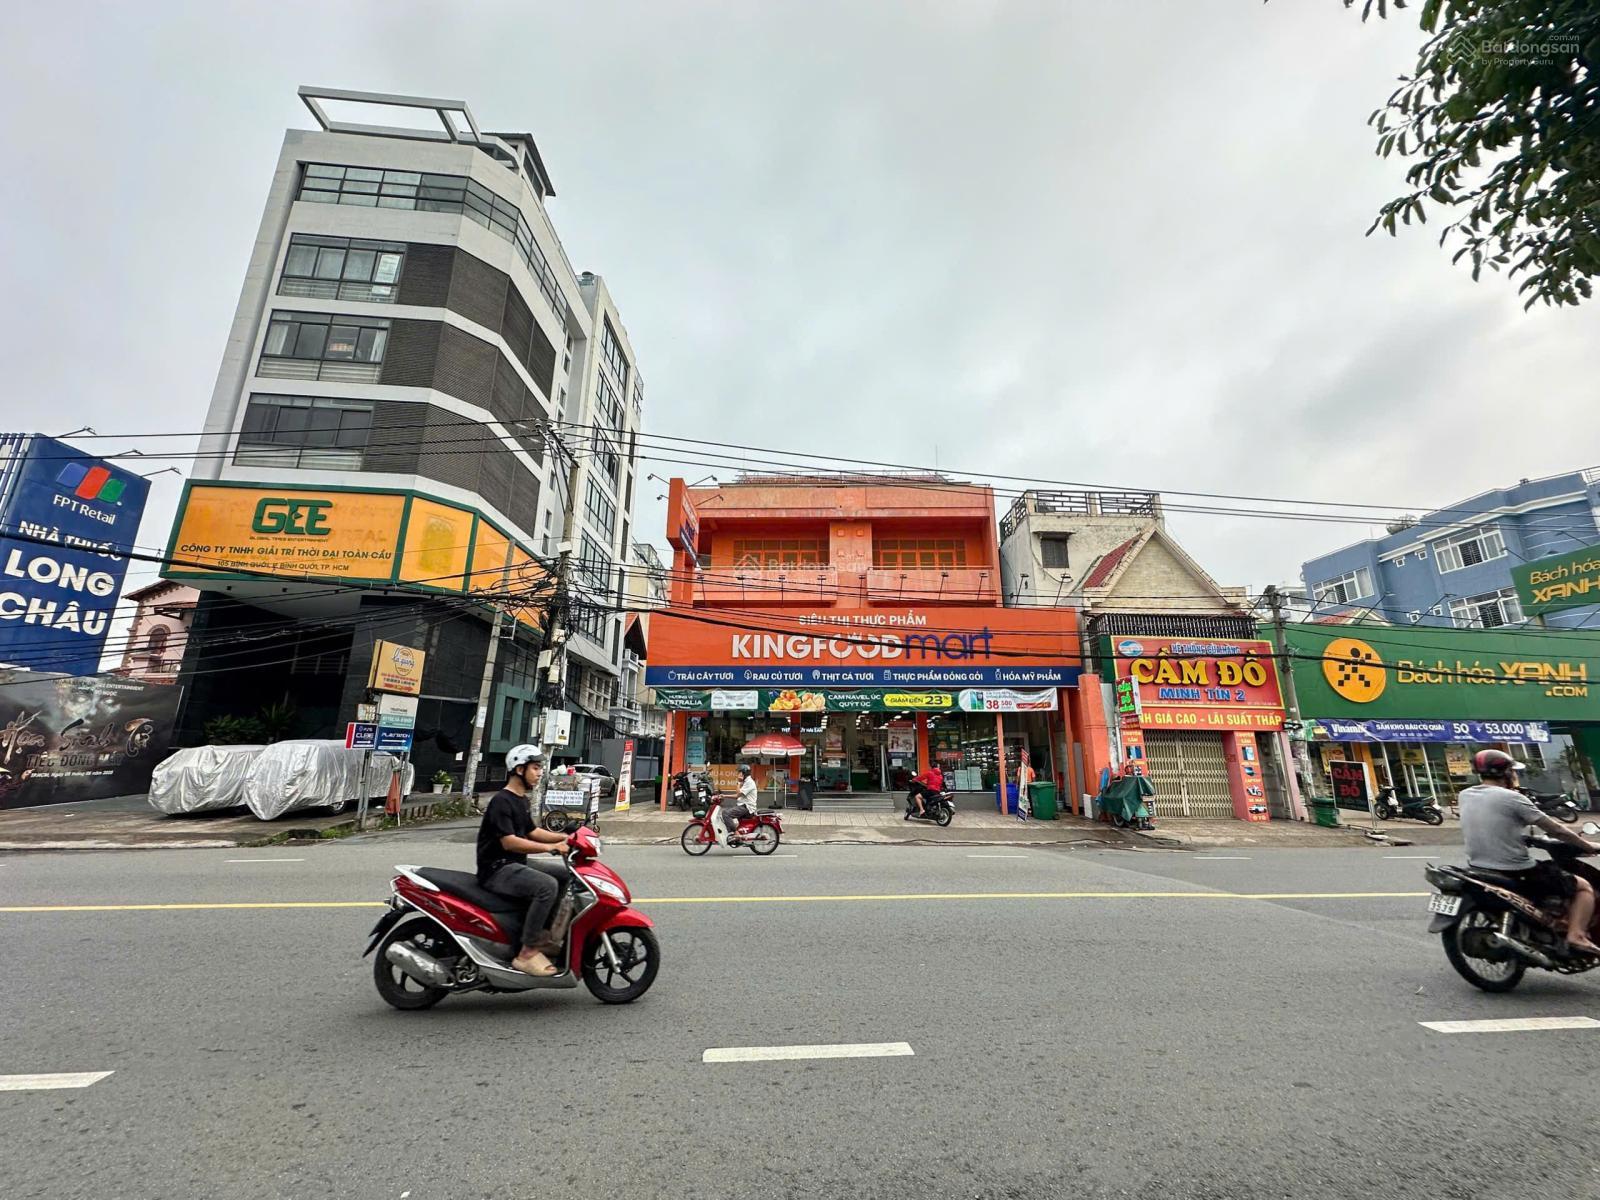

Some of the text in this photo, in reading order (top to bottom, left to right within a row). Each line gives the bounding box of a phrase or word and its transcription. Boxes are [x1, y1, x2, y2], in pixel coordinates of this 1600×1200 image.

[53, 494, 116, 525] FPT Retail
[18, 520, 60, 542] NHÀ
[181, 543, 211, 553] CÔNG
[257, 546, 279, 556] GIẢI
[281, 547, 296, 556] TRÍ
[298, 547, 320, 557] THỜI
[322, 549, 339, 559] ĐẠI
[342, 549, 369, 559] TOÀN
[4, 548, 115, 597] LONG
[1530, 557, 1600, 585] Bách hóa
[1531, 577, 1600, 604] XANH
[0, 592, 108, 636] CHÂU
[829, 616, 850, 627] THỊ
[852, 614, 886, 627] THỰC
[889, 610, 927, 625] PHẨM
[1131, 647, 1267, 687] CẦM ĐỒ
[1397, 660, 1587, 685] Bách hóa XANH
[676, 670, 734, 680] TRÁI CÂY TƯƠI
[753, 671, 803, 681] RAU CỦ TƯƠI
[821, 671, 874, 682] THỊT CÁ TƯƠI
[893, 668, 983, 682] THỰC PHẨM ĐÓNG GÓI
[1003, 669, 1062, 681] HÓA MỸ PHẨM
[1159, 687, 1246, 701] MINH TÍN 2
[1545, 686, 1588, 697] .COM
[859, 699, 871, 707] ÚC
[986, 700, 999, 709] 38
[1155, 711, 1172, 724] GIÁ
[1177, 713, 1197, 725] CAO
[1208, 712, 1224, 725] LÃI
[1227, 711, 1252, 725] SUẤT
[1256, 711, 1281, 726] THẤP
[1485, 723, 1524, 734] 53.000
